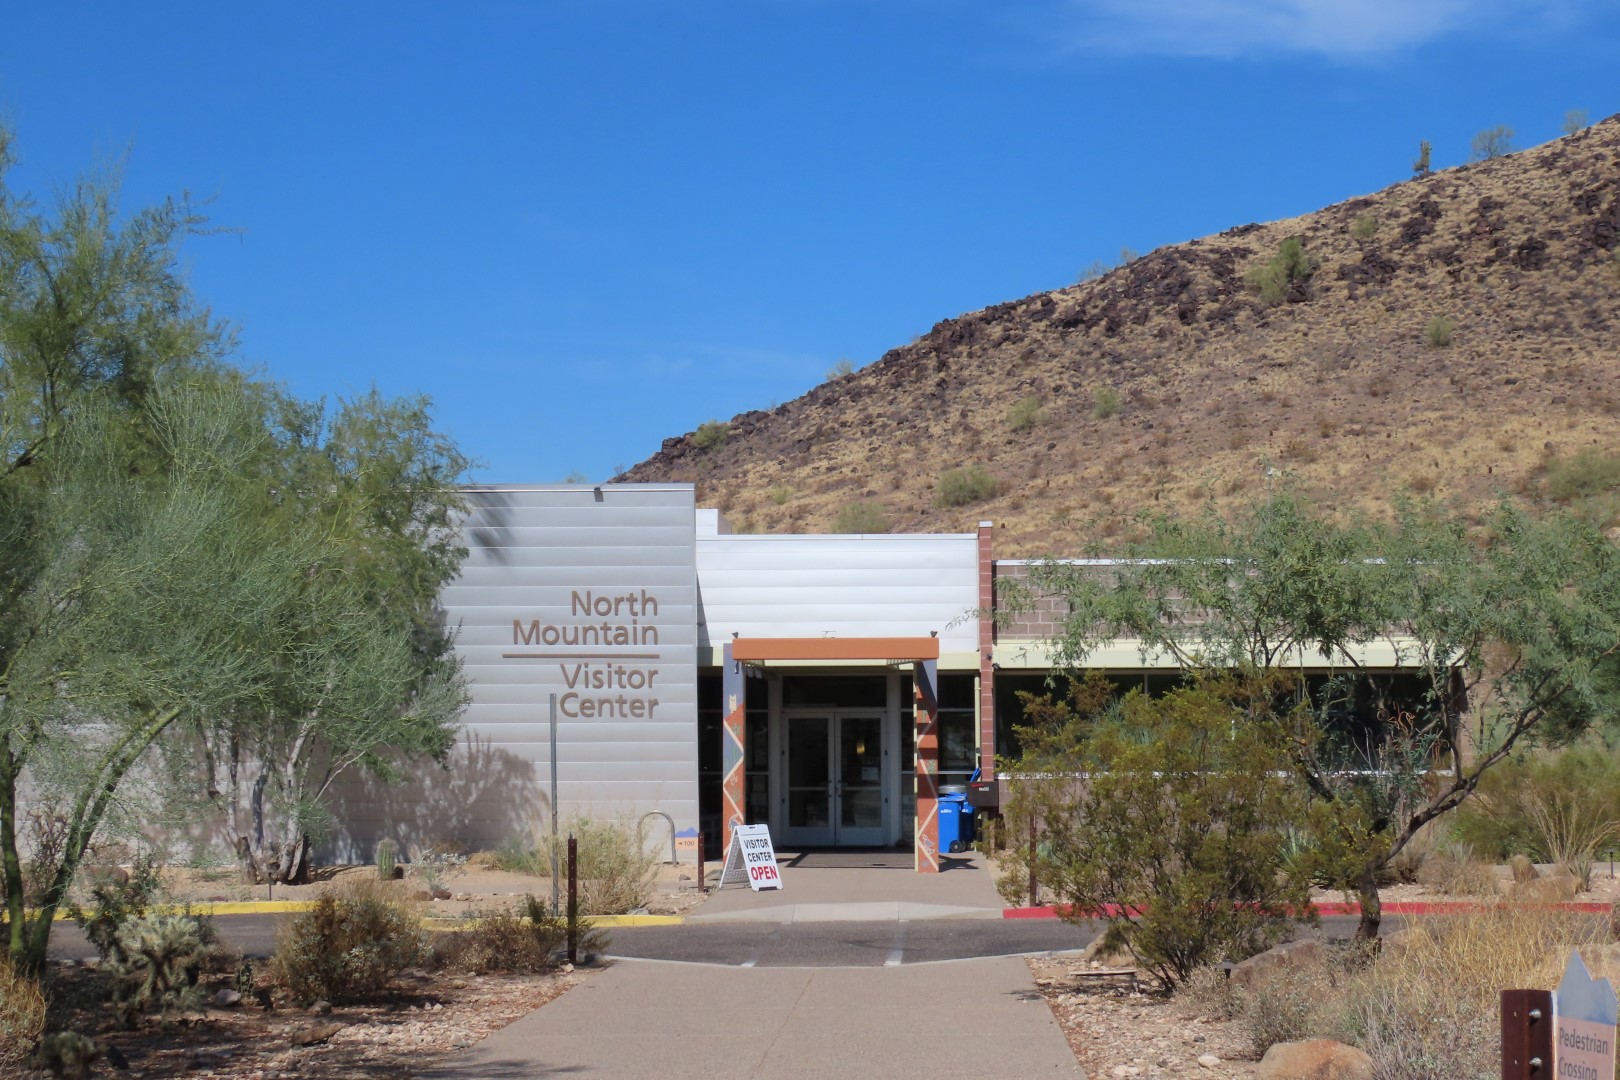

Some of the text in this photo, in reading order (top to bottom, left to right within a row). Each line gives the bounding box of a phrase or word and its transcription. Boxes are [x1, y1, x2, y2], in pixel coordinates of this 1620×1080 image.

[571, 589, 658, 616] North
[513, 619, 659, 645] Mountain
[560, 662, 659, 689] Visitor
[560, 692, 659, 719] Center
[744, 838, 769, 849] VISITOR
[747, 851, 773, 862] CENTER
[751, 865, 778, 880] OPEN
[1559, 1028, 1608, 1054] Pedestrian
[1559, 1056, 1598, 1080] Crossing
